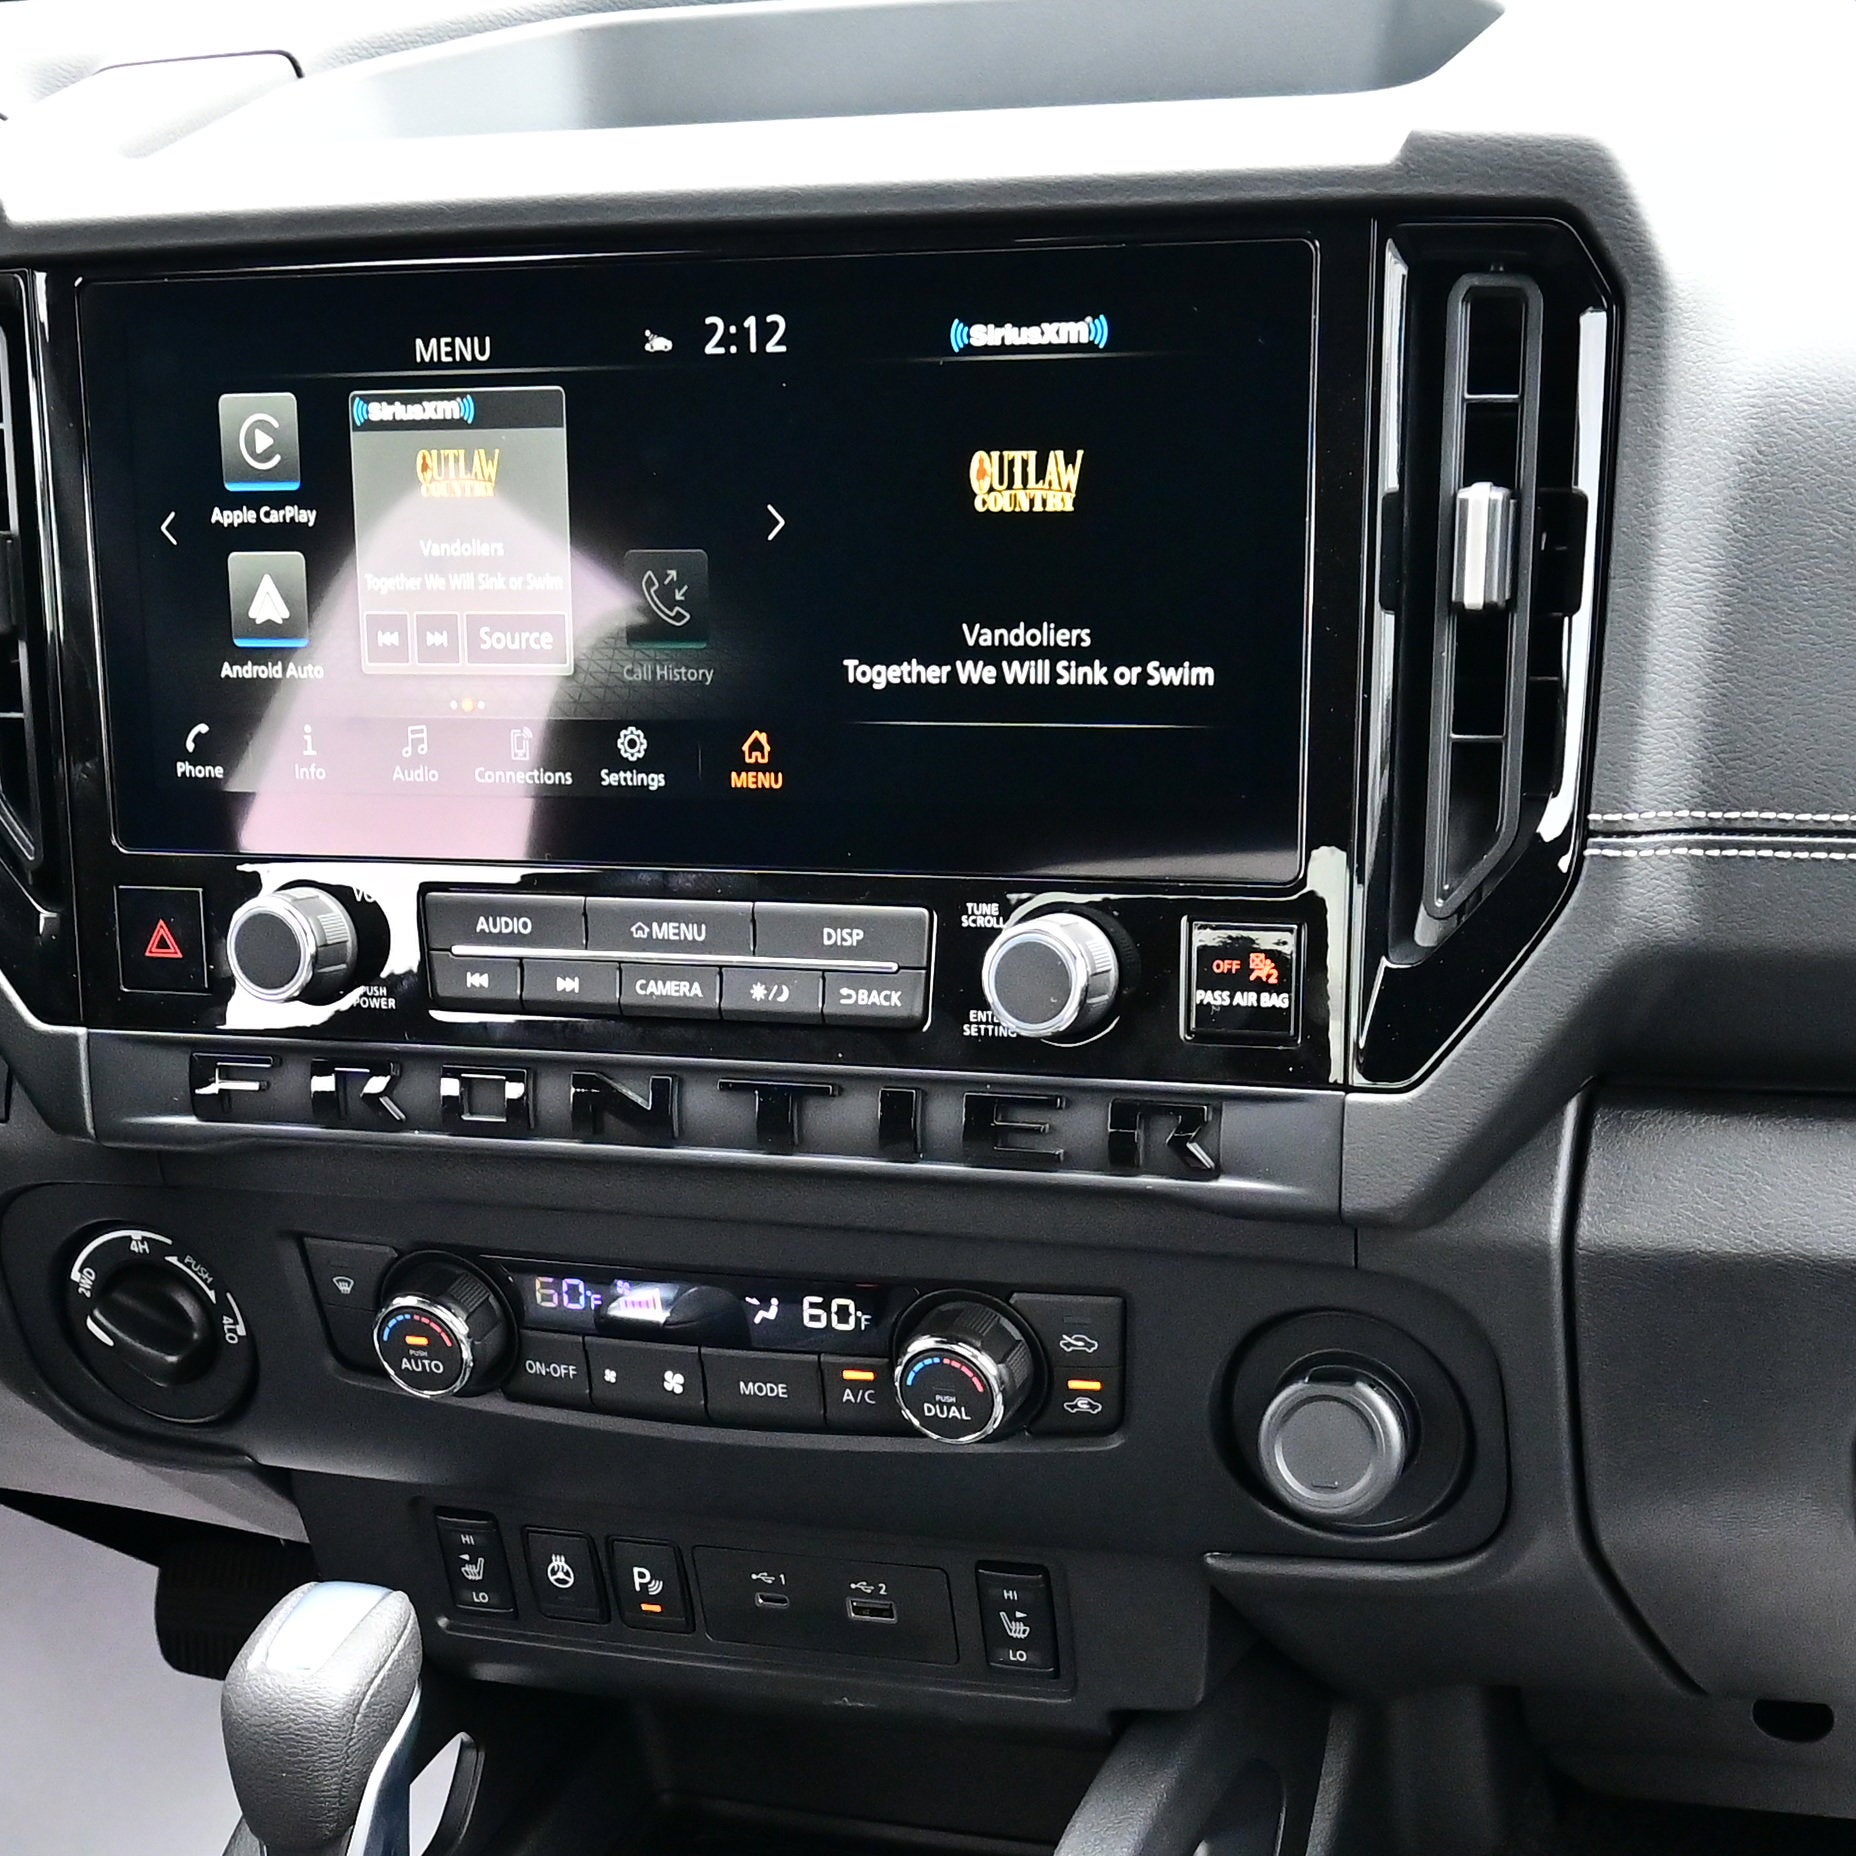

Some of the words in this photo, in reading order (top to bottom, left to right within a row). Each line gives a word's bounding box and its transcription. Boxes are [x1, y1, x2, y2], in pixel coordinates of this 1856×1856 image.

[704, 314, 789, 355] 2:12
[415, 336, 491, 364] MENU
[416, 448, 500, 484] OUTLAW
[969, 449, 1084, 494] OUTLAW
[974, 490, 1075, 512] COUNTRY
[211, 506, 256, 528] Apple
[259, 503, 317, 527] CarPlay
[364, 573, 421, 595] Together
[425, 573, 445, 590] We
[448, 573, 475, 590] Will
[478, 573, 506, 591] Sink
[509, 577, 523, 590] or
[479, 626, 553, 650] Source
[962, 622, 1091, 647] Vandoliers
[221, 661, 282, 681] Android
[285, 662, 324, 680] Auto
[623, 664, 654, 682] Call
[657, 664, 714, 687] History
[844, 658, 950, 690] Together
[956, 660, 997, 685] We
[1001, 660, 1050, 685] Will
[1056, 661, 1109, 686] Sink
[1114, 666, 1140, 686] or
[1146, 662, 1214, 686] Swim
[176, 761, 224, 780] Phone
[295, 763, 326, 780] Info
[393, 765, 439, 783] Audio
[474, 767, 573, 786] Connections
[601, 768, 665, 790] Settings
[731, 772, 783, 789] MENU
[966, 902, 1000, 916] TUNE
[476, 914, 532, 936] AUDIO
[961, 915, 1006, 929] SCROLL
[651, 922, 706, 943] MENU
[823, 928, 864, 948] DISP
[1212, 959, 1241, 974] OFF
[363, 985, 387, 997] PUSH
[635, 979, 703, 999] CAMERA
[858, 989, 902, 1008] BACK
[353, 997, 396, 1010] POWER
[1196, 989, 1231, 1006] PASS
[1232, 991, 1258, 1007] AIR
[1260, 992, 1289, 1009] BAG
[188, 1050, 1221, 1181] FRONTIER
[129, 1239, 150, 1256] 4H
[183, 1254, 213, 1284] PUSH
[78, 1267, 97, 1299] 2WD
[221, 1315, 240, 1346] 4LO
[408, 1349, 428, 1358] PUSH
[400, 1357, 444, 1375] AUTO
[739, 1380, 788, 1399] MODE
[842, 1388, 877, 1404] A/C
[935, 1394, 956, 1403] PUSH
[923, 1403, 972, 1421] DUAL
[461, 1534, 475, 1546] HI
[632, 1567, 651, 1592] P
[878, 1583, 887, 1595] 2
[472, 1591, 489, 1603] LO
[1003, 1589, 1018, 1601] HI
[1009, 1650, 1027, 1662] LO
